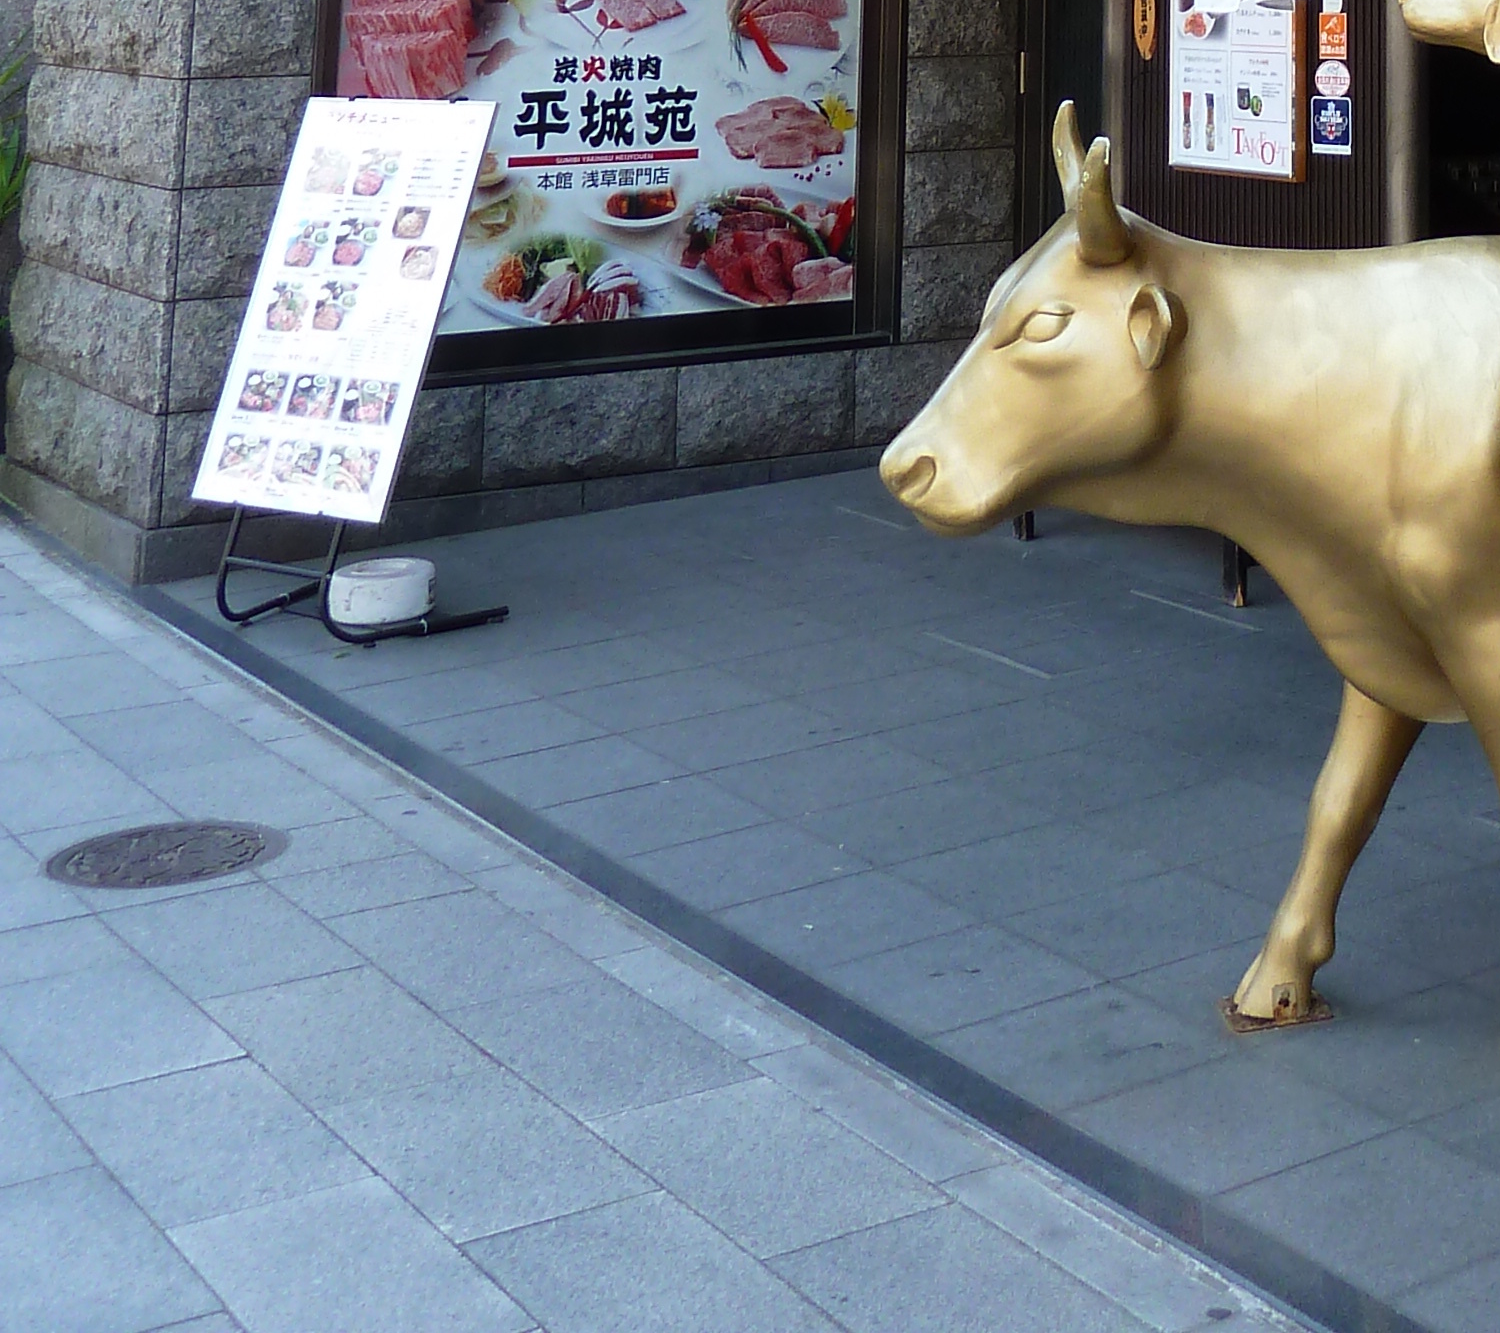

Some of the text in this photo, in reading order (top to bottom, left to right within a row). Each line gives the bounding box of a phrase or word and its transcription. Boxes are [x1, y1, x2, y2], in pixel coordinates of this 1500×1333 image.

[552, 53, 663, 84] 炭火焼肉
[513, 84, 699, 151] 平城苑
[537, 166, 671, 191] 本館 浅草雷門店
